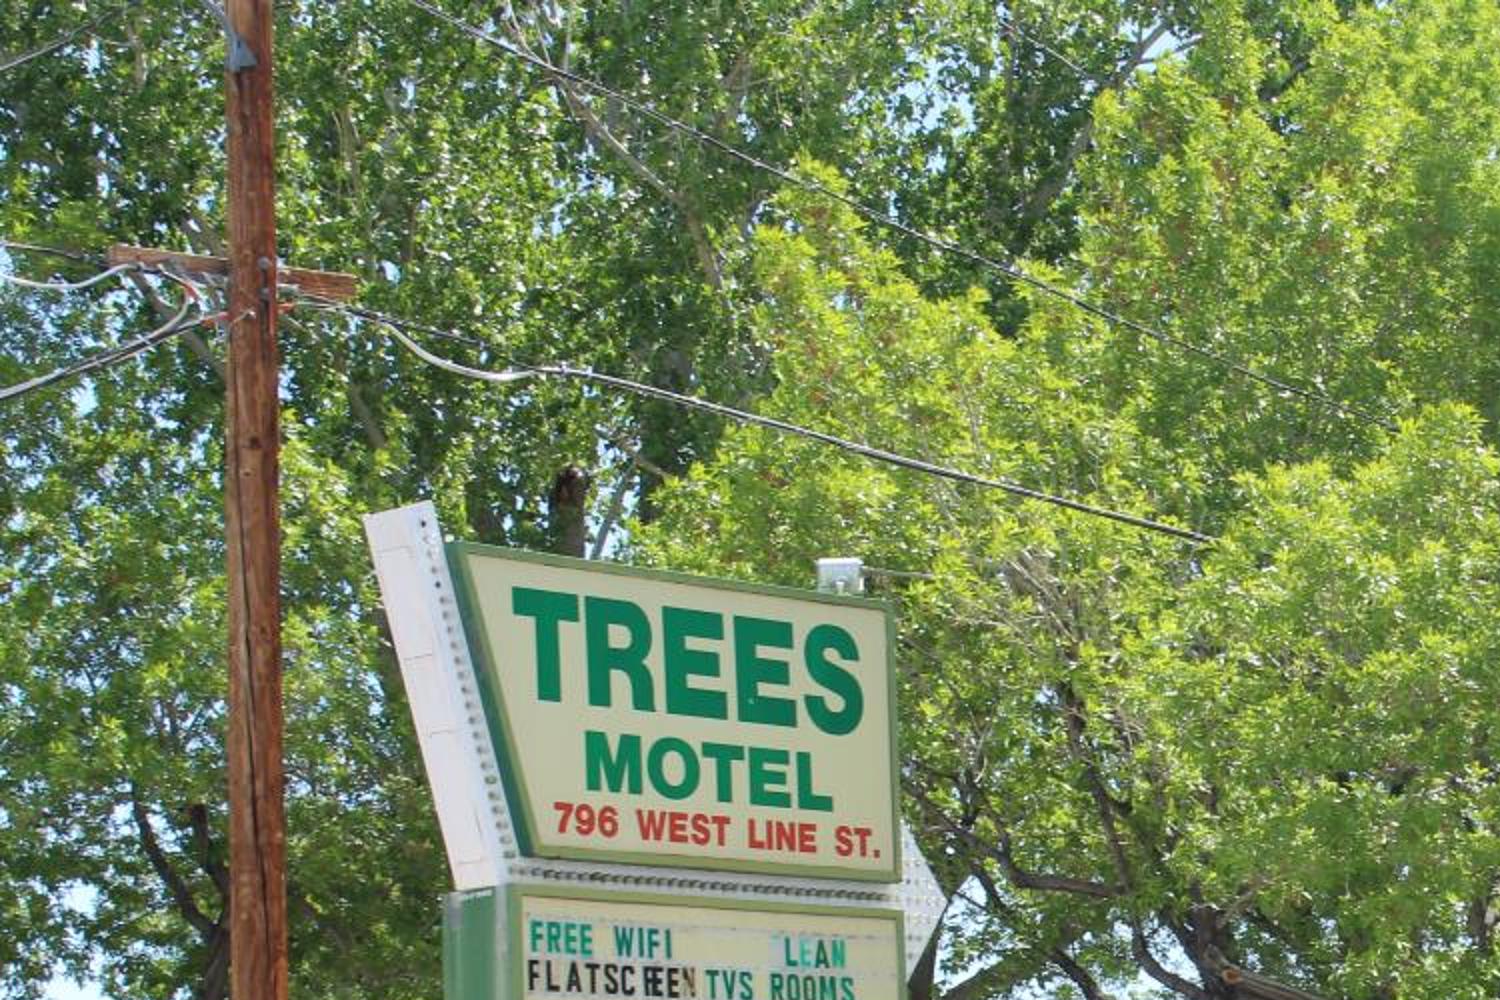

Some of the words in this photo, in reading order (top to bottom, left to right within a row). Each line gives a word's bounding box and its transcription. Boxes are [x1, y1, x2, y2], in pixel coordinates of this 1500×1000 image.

[512, 586, 864, 736] TREES
[585, 731, 833, 812] MOTEL
[553, 801, 619, 838] 796
[636, 808, 730, 847] WEST
[748, 819, 817, 855] LINE
[835, 826, 881, 858] ST.
[530, 920, 593, 958] FREE
[613, 925, 673, 959] WIFI
[705, 969, 754, 1000] TVS
